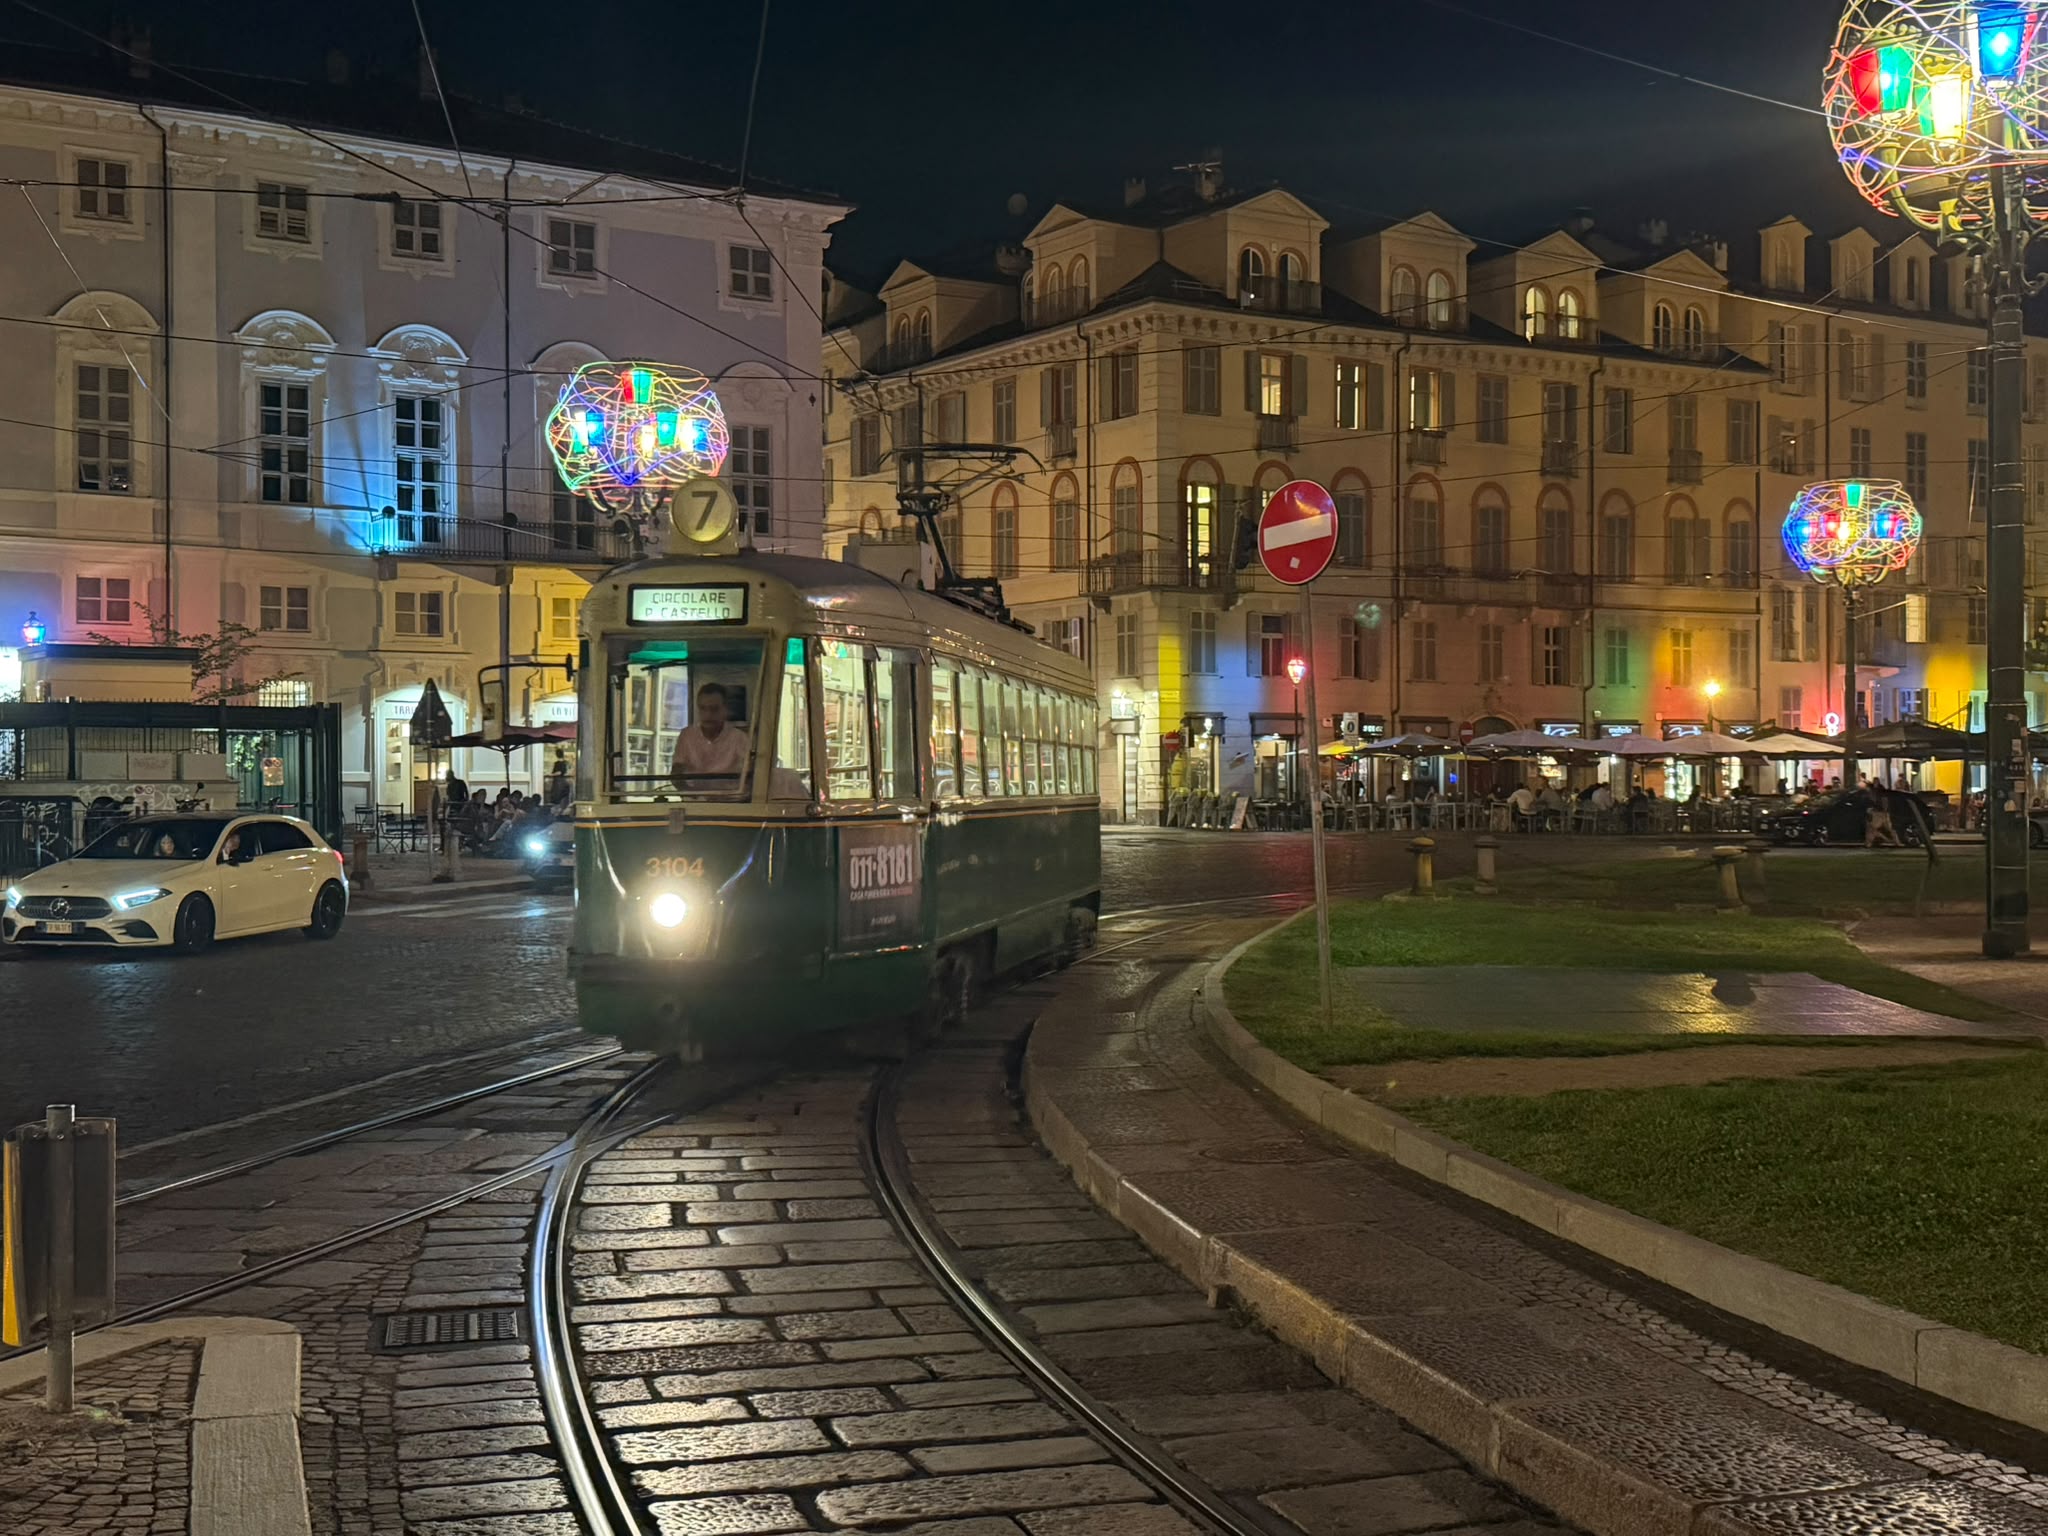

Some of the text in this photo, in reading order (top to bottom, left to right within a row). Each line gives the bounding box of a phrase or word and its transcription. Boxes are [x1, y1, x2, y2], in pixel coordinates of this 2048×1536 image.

[691, 489, 718, 531] 7
[652, 592, 727, 604] CIRCOLARE
[661, 607, 731, 619] CASTELLO
[645, 857, 705, 877] 3104
